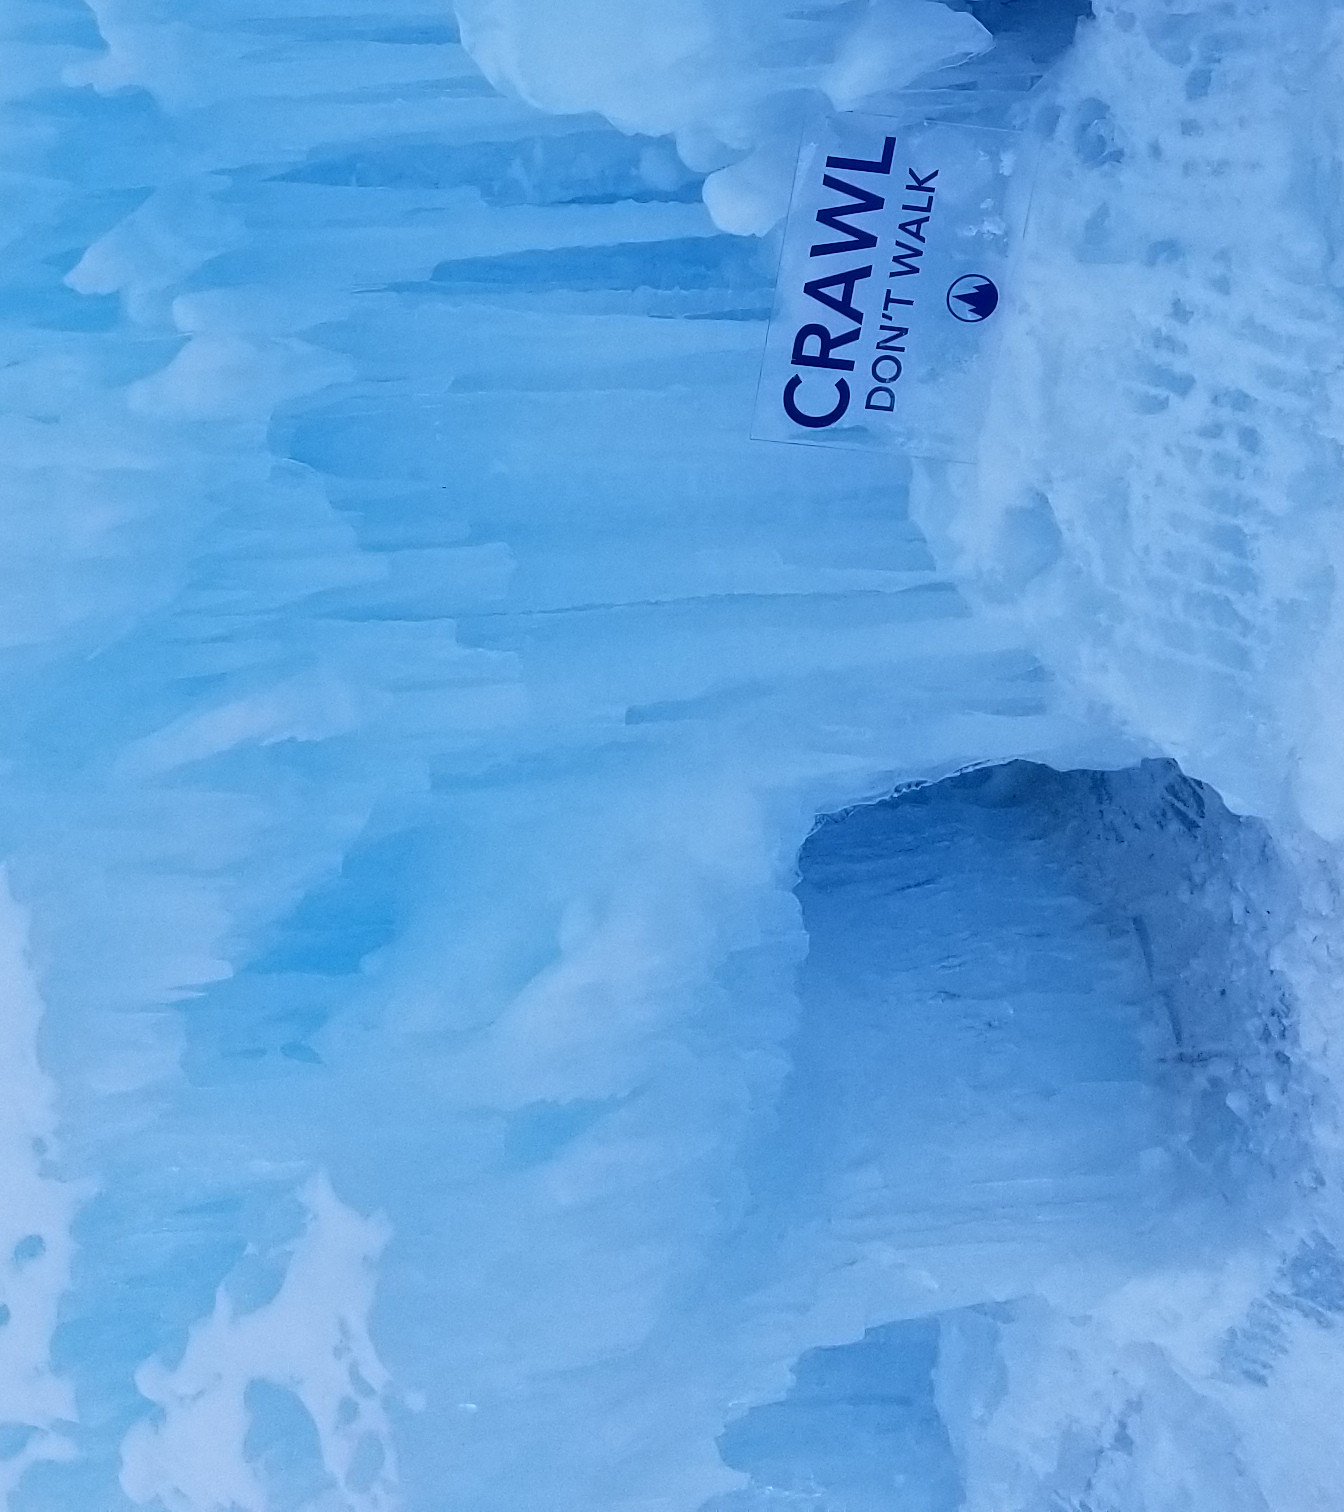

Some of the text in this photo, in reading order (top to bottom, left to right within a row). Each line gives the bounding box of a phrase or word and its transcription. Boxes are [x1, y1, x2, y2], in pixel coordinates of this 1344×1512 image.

[783, 136, 897, 428] CRAWL
[864, 167, 939, 412] DON'T WALK
